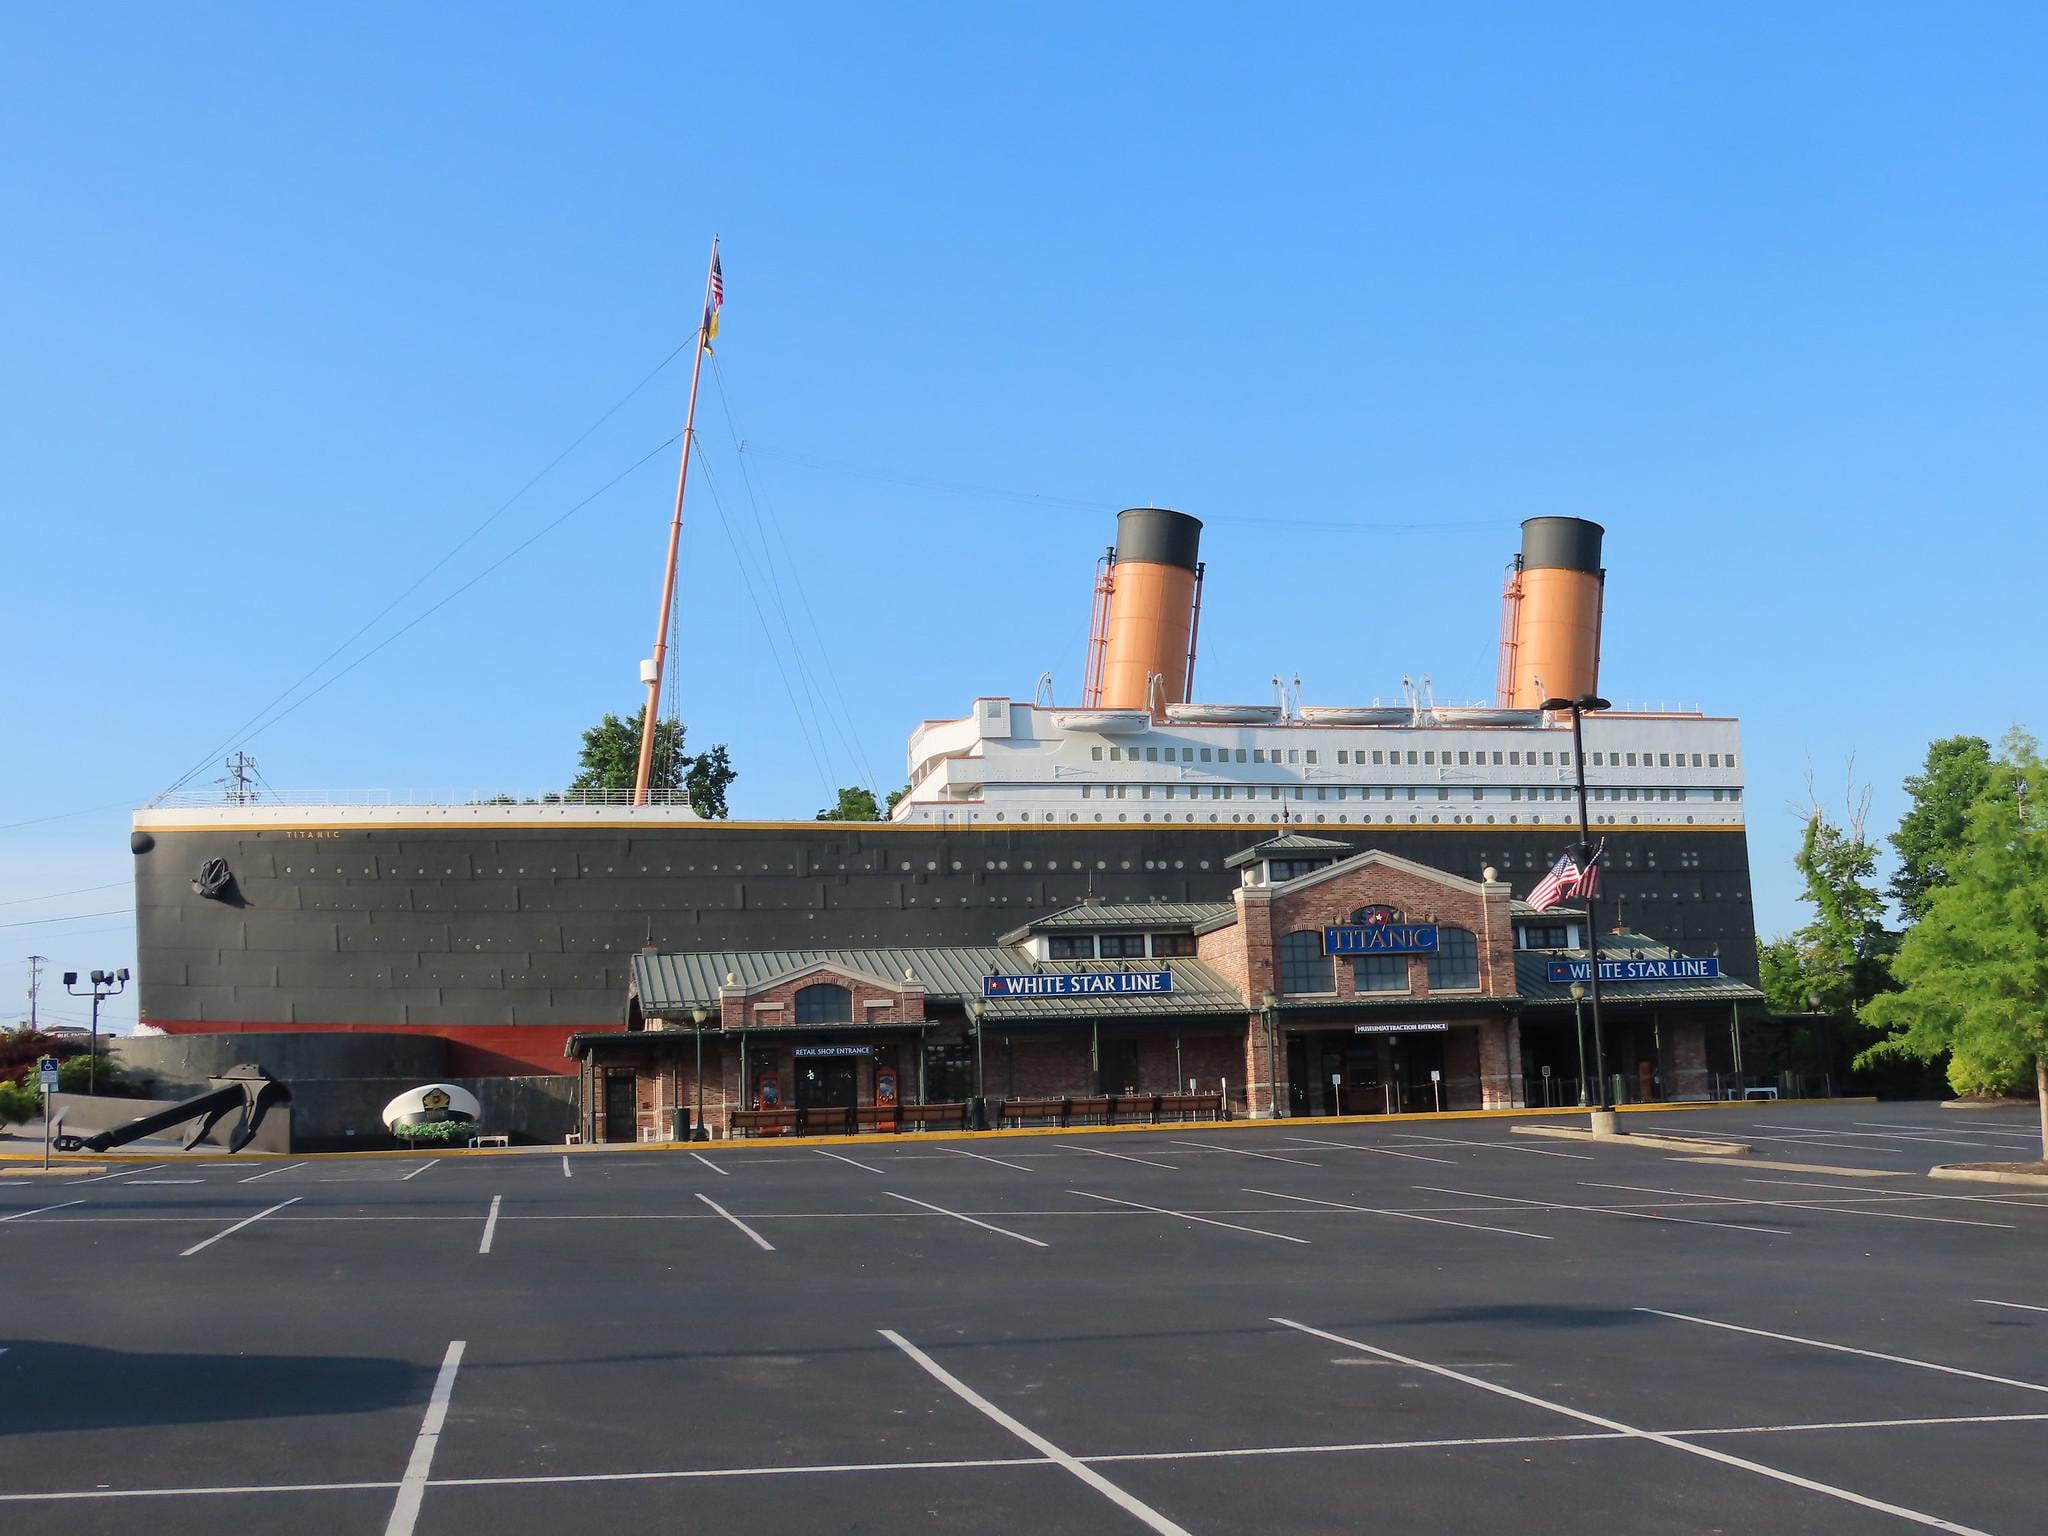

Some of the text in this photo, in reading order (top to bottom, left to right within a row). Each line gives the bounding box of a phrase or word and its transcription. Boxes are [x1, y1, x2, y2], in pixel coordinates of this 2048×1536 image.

[286, 831, 340, 839] TITANIC
[1330, 927, 1433, 950] TITANIC
[1627, 962, 1667, 978] STAR
[1672, 960, 1709, 976] LINE
[1005, 974, 1162, 994] WHITE STAR LINE
